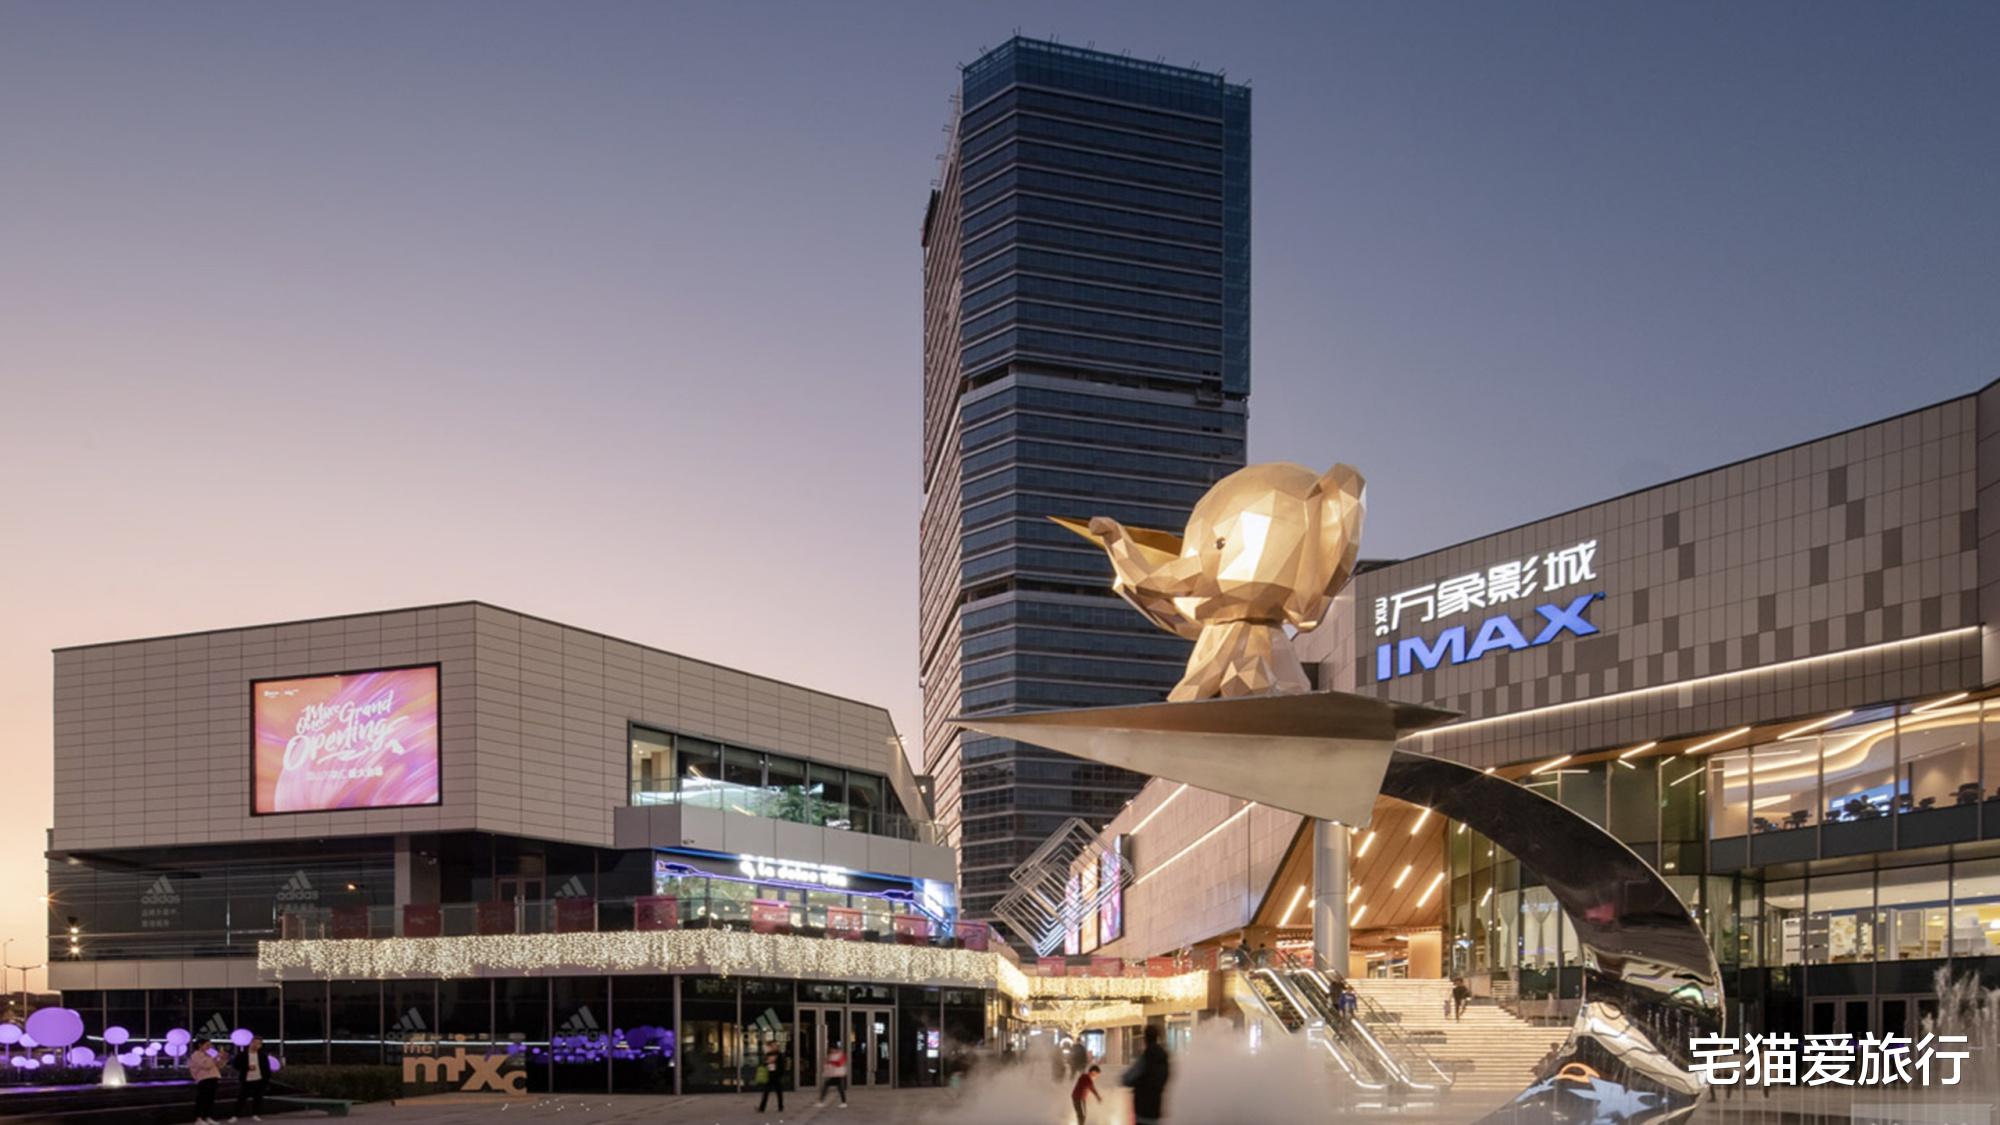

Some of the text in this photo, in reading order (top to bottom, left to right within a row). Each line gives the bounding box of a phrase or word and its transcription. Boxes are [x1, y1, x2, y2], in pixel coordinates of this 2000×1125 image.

[1390, 539, 1597, 631] 万象影城
[1376, 593, 1600, 681] IMAX
[339, 689, 394, 723] Grand
[283, 716, 408, 771] Opening
[141, 894, 181, 905] adidas
[276, 889, 319, 900] adidas
[402, 1034, 528, 1095] mixc
